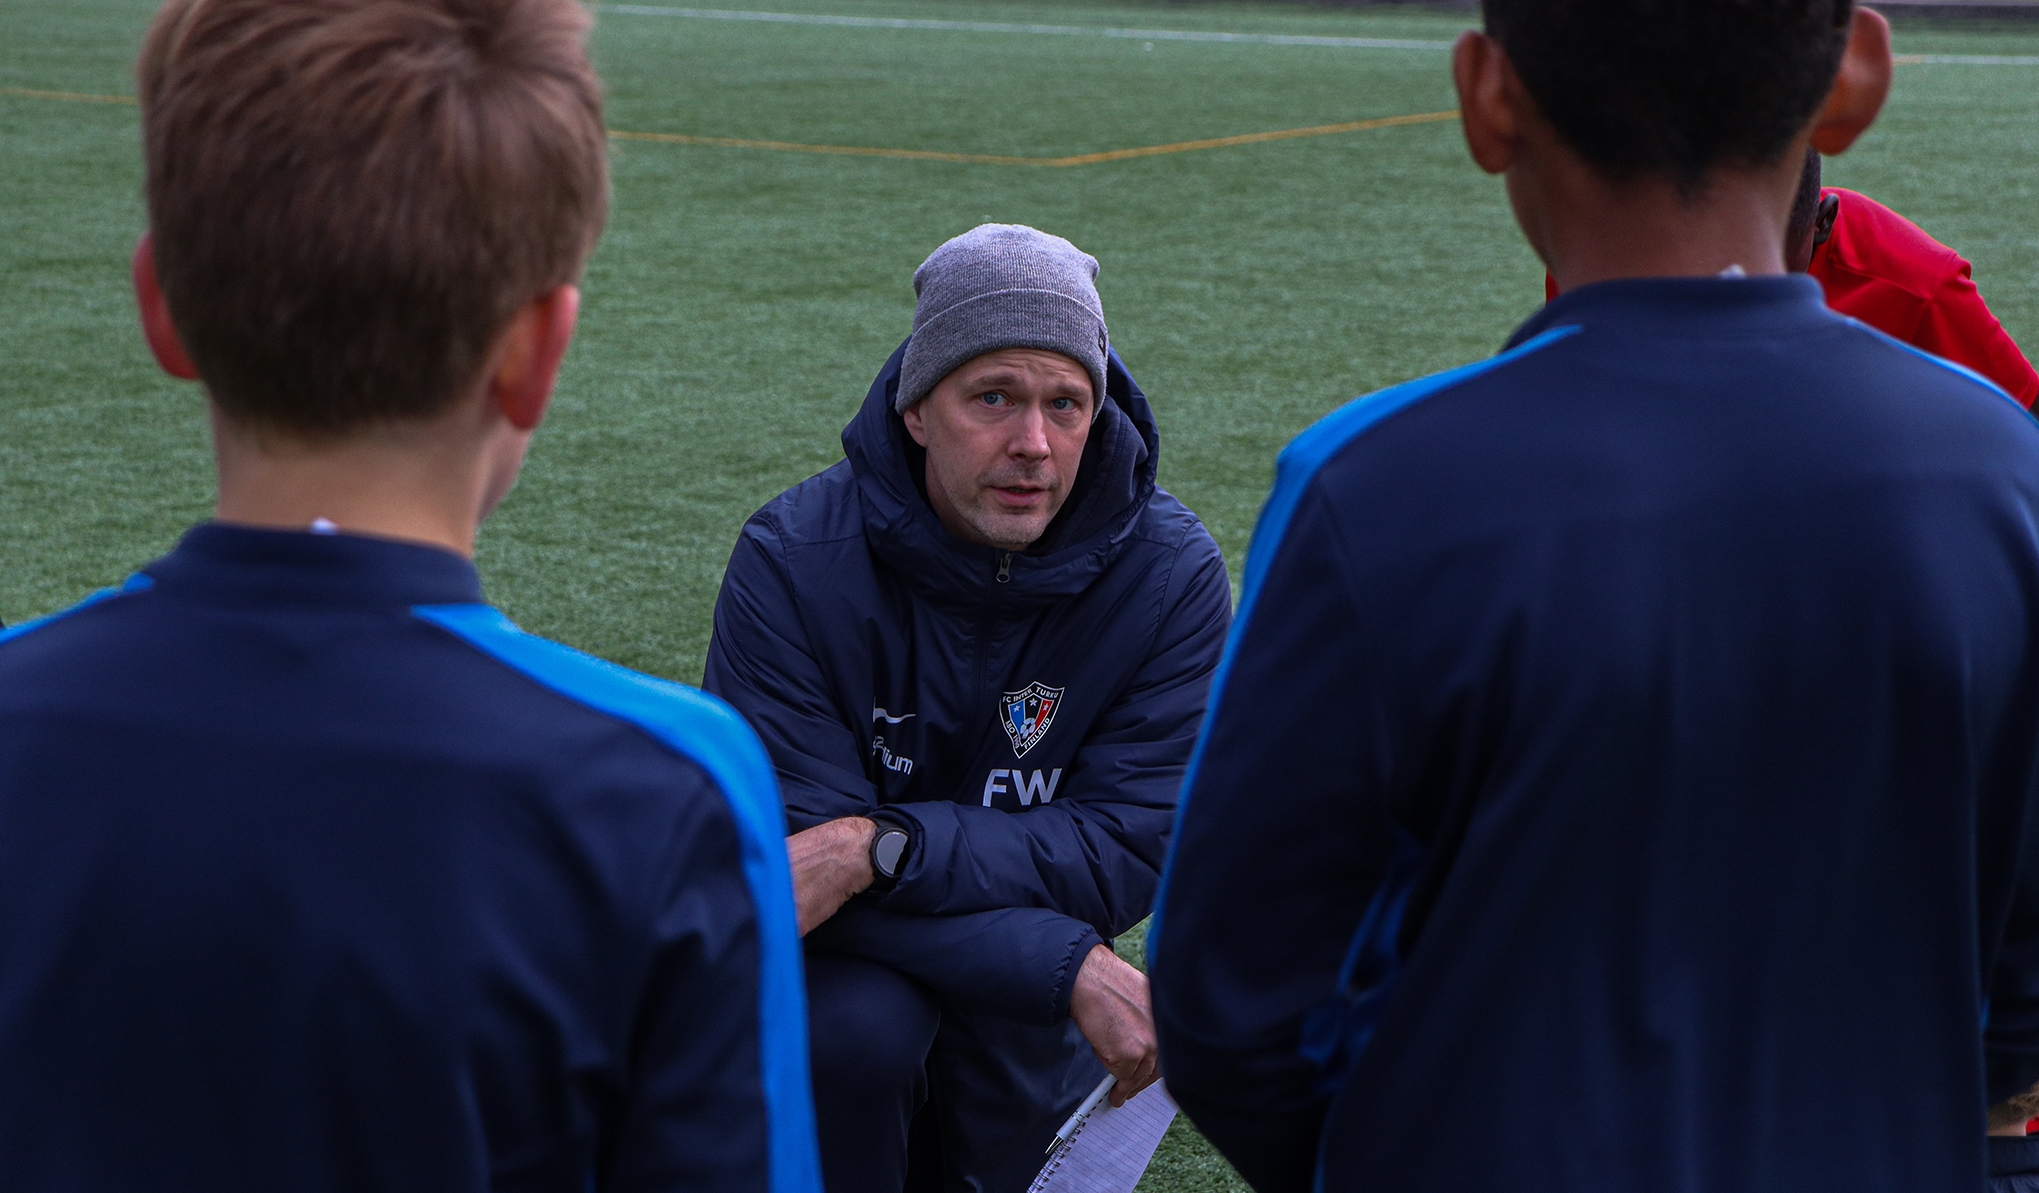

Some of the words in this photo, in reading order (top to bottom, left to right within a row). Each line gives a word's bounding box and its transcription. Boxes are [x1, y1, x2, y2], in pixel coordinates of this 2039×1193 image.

[1013, 688, 1033, 702] INTER
[1035, 686, 1059, 699] TURKU
[1024, 718, 1050, 749] FINLAND
[983, 768, 1062, 807] FW
